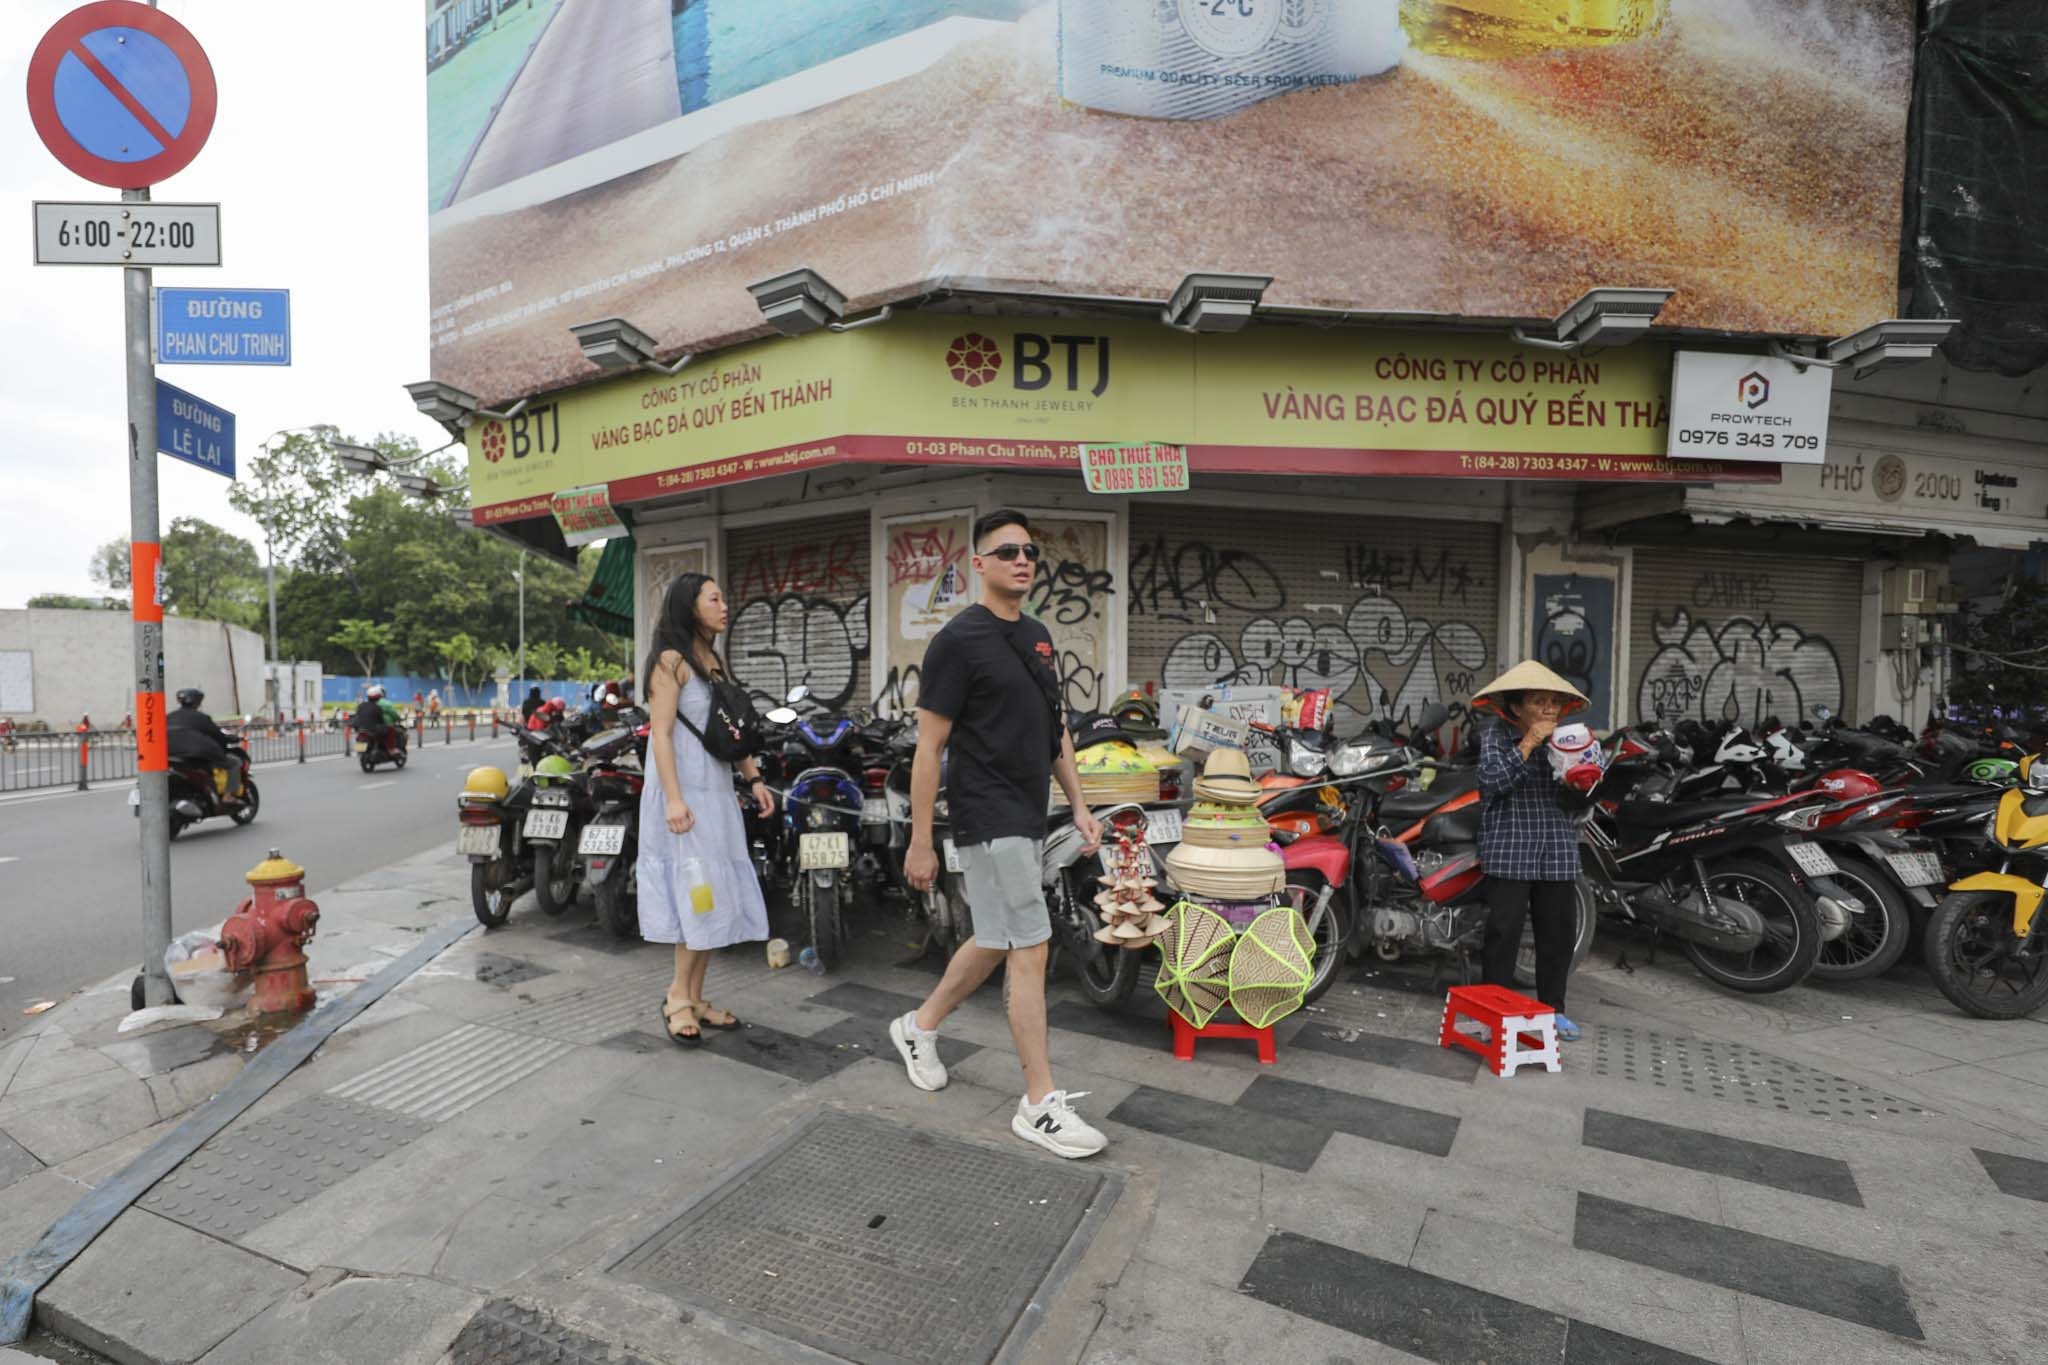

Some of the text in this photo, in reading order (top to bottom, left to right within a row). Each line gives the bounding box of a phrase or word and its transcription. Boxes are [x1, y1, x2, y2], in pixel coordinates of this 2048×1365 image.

[1160, 71, 1221, 85] QUALITY
[1224, 74, 1260, 87] BEER
[728, 226, 762, 248] QUẬN
[775, 208, 817, 233] THÀNH
[818, 193, 846, 219] PHỐ
[870, 178, 895, 201] CHÍ
[896, 172, 935, 193] MINH
[188, 297, 262, 319] ĐƯỜNG
[167, 333, 284, 356] PHAN CHU TRINH
[1013, 333, 1110, 398] BTJ
[1374, 352, 1600, 385] CÔNG TY CỔ PHẦN
[642, 385, 678, 410] CÔNG
[681, 382, 698, 399] TY
[723, 362, 762, 388] PHẦN
[172, 397, 222, 434] ĐƯỜNG
[592, 378, 833, 451] VÀNG BẠC ĐÁ QUÝ BẾN THÀNH
[951, 397, 1094, 412] BEN THANH JEWELRY
[1263, 390, 1346, 422] VÀNG
[1355, 394, 1416, 430] BẠC
[1426, 391, 1468, 425] ĐÁ
[1476, 391, 1537, 427] QUÝ
[1546, 387, 1606, 428] BẾN
[510, 402, 560, 459] BTJ
[1711, 413, 1792, 427] PROWTECH
[197, 438, 221, 466] LAI
[906, 441, 947, 456] 01-03
[950, 442, 984, 457] Phan
[988, 443, 1015, 457] Chu
[1016, 444, 1057, 460] Trinh,
[1679, 429, 1819, 450] 0976 343 709
[1088, 448, 1116, 466] CHO
[1118, 442, 1152, 465] THUÊ
[1474, 455, 1520, 471] (84-28)
[1523, 456, 1554, 470] 7303
[1556, 457, 1588, 472] 4347
[1620, 460, 1723, 476] www.btj.com.vn
[1104, 465, 1184, 490] 0896 661 552
[1915, 472, 1961, 501] 2000
